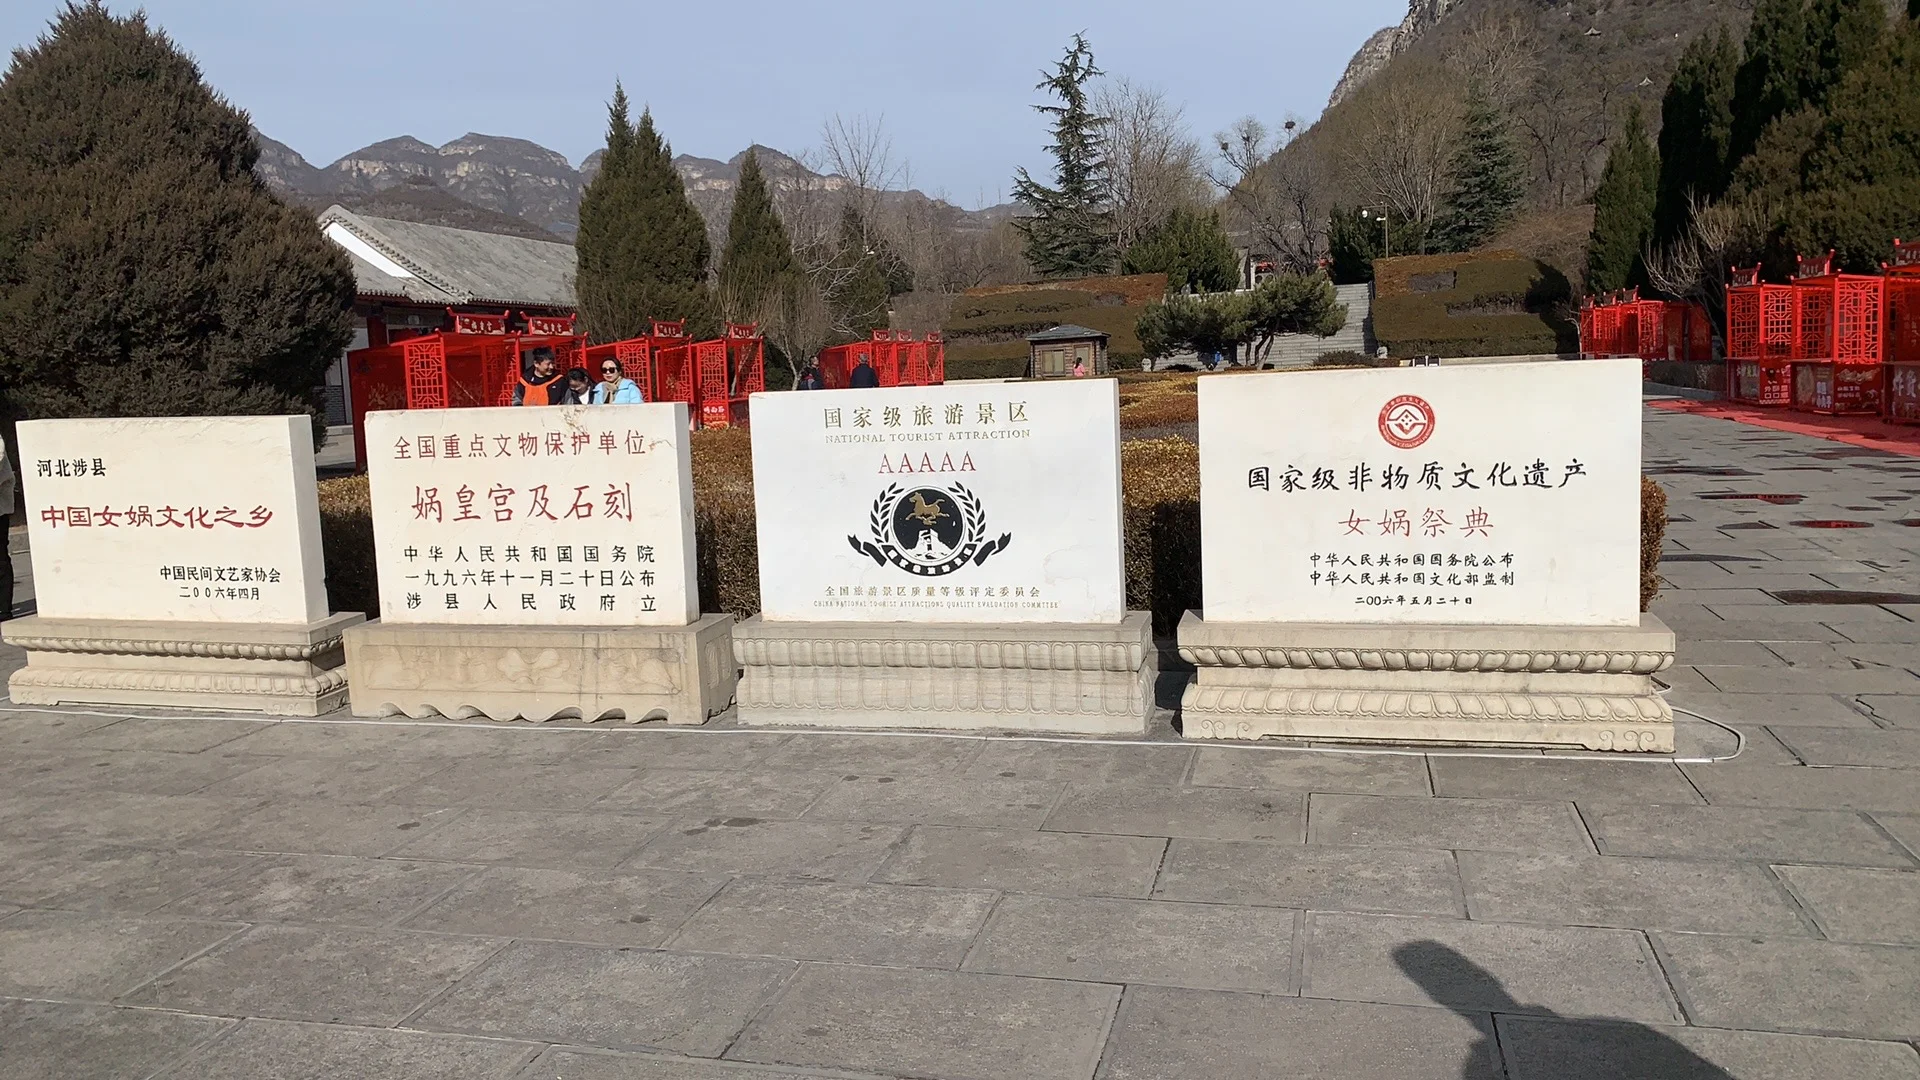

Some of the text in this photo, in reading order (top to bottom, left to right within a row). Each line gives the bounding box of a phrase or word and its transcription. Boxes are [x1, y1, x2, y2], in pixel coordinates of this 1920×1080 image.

[824, 401, 1029, 429] 国家级旅游景区
[393, 429, 647, 460] 全国重点文物保护单位
[825, 429, 1031, 444] NATIONAL TOURIST ATTRACTION
[36, 458, 107, 478] 河北涉县
[878, 451, 977, 474] AAAAA
[1247, 457, 1588, 492] 国家级非物质文化遗产
[411, 482, 634, 523] 娲皇宫及石刻
[41, 505, 274, 530] 中国女娲文化之乡
[1338, 506, 1495, 538] 女娲祭典
[403, 545, 656, 564] 中华人民共和国国务院
[1309, 552, 1515, 568] 中华人民共和国国务院公布
[160, 565, 281, 583] 中国民间文艺家协会
[405, 569, 656, 588] 一九九六年十一月二十日公布
[1309, 570, 1515, 587] 中华人民共和国文化部监制
[825, 585, 1041, 597] 全国旅游景区质量等级评定委员会
[406, 592, 657, 612] 涉县人民政府立
